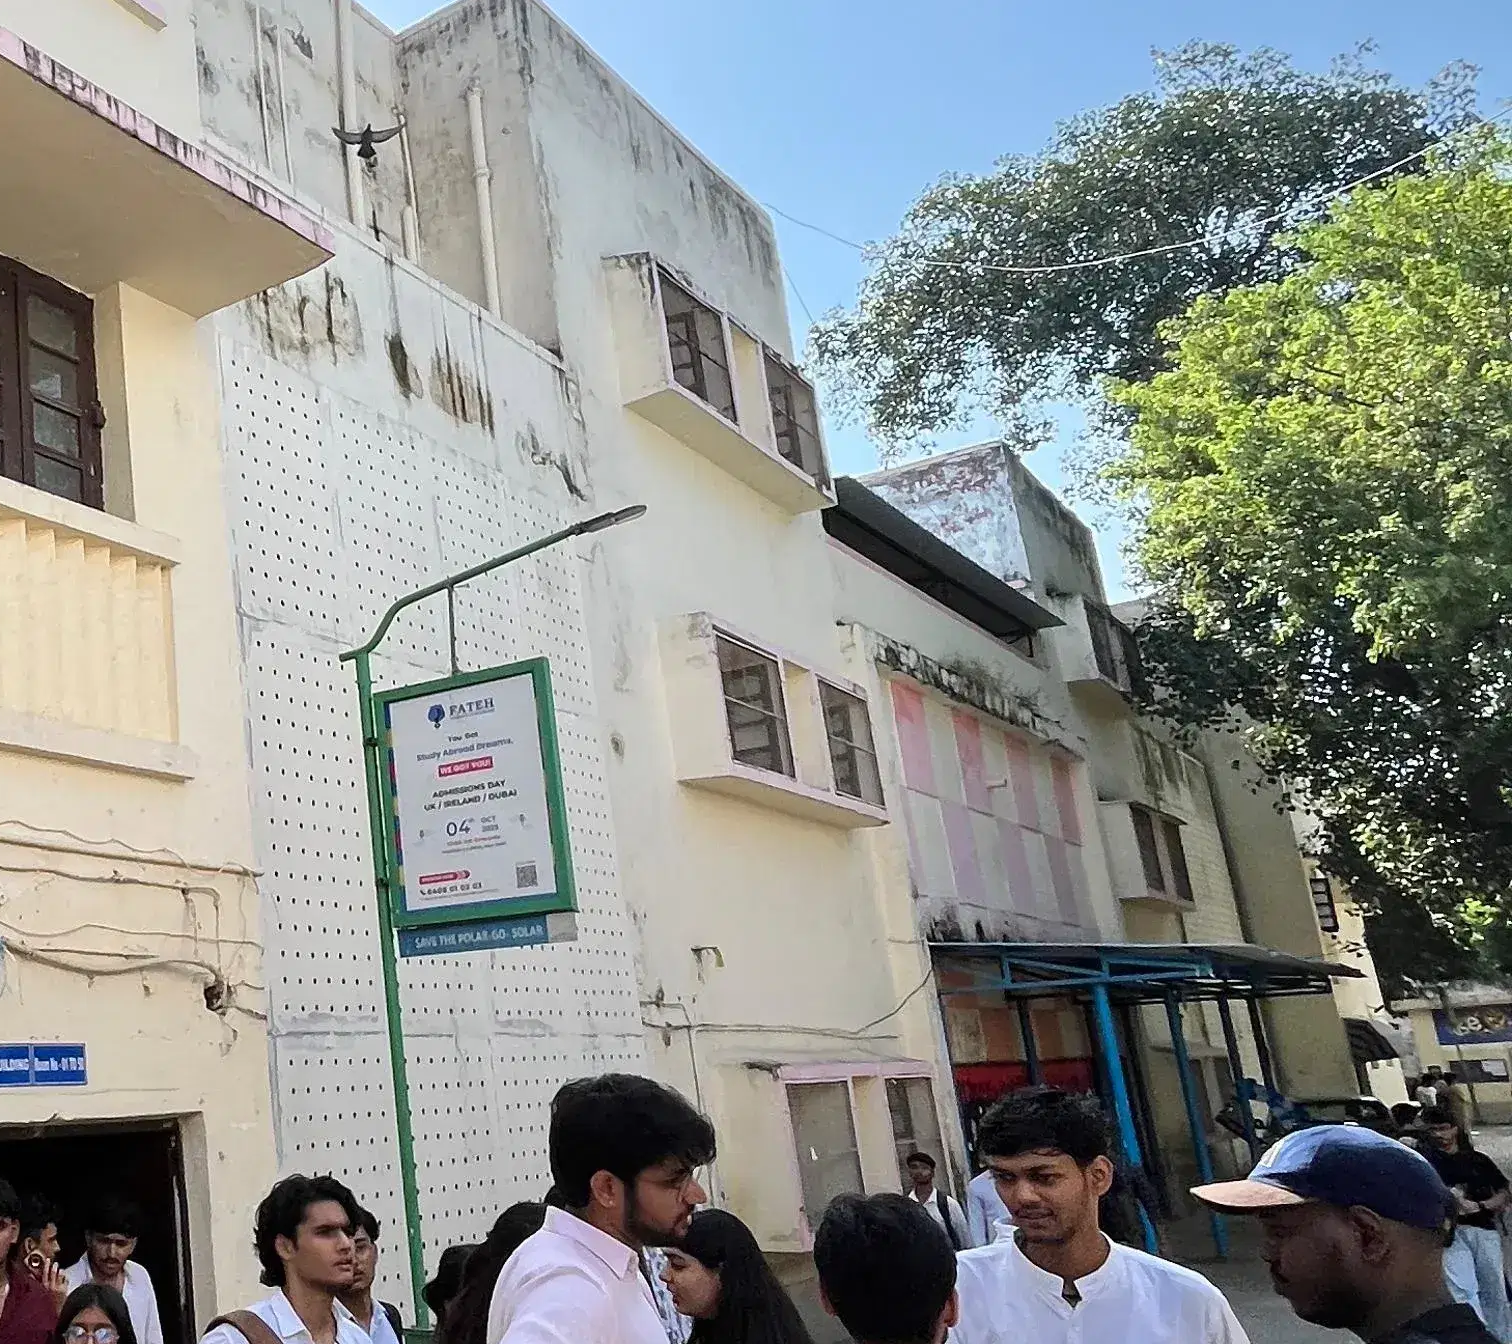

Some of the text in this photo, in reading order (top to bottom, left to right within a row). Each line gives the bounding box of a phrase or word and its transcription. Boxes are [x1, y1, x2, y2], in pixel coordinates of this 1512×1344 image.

[449, 698, 495, 716] FATEH
[443, 744, 475, 756] Abroad
[432, 779, 506, 798] ADMISSIONS DAY
[423, 803, 436, 811] UK
[443, 796, 481, 808] IRELAND
[488, 789, 517, 800] DUBAI
[414, 935, 437, 948] SAVE
[438, 933, 456, 946] THE
[458, 930, 489, 944] POLAR
[511, 925, 543, 939] SOLAR
